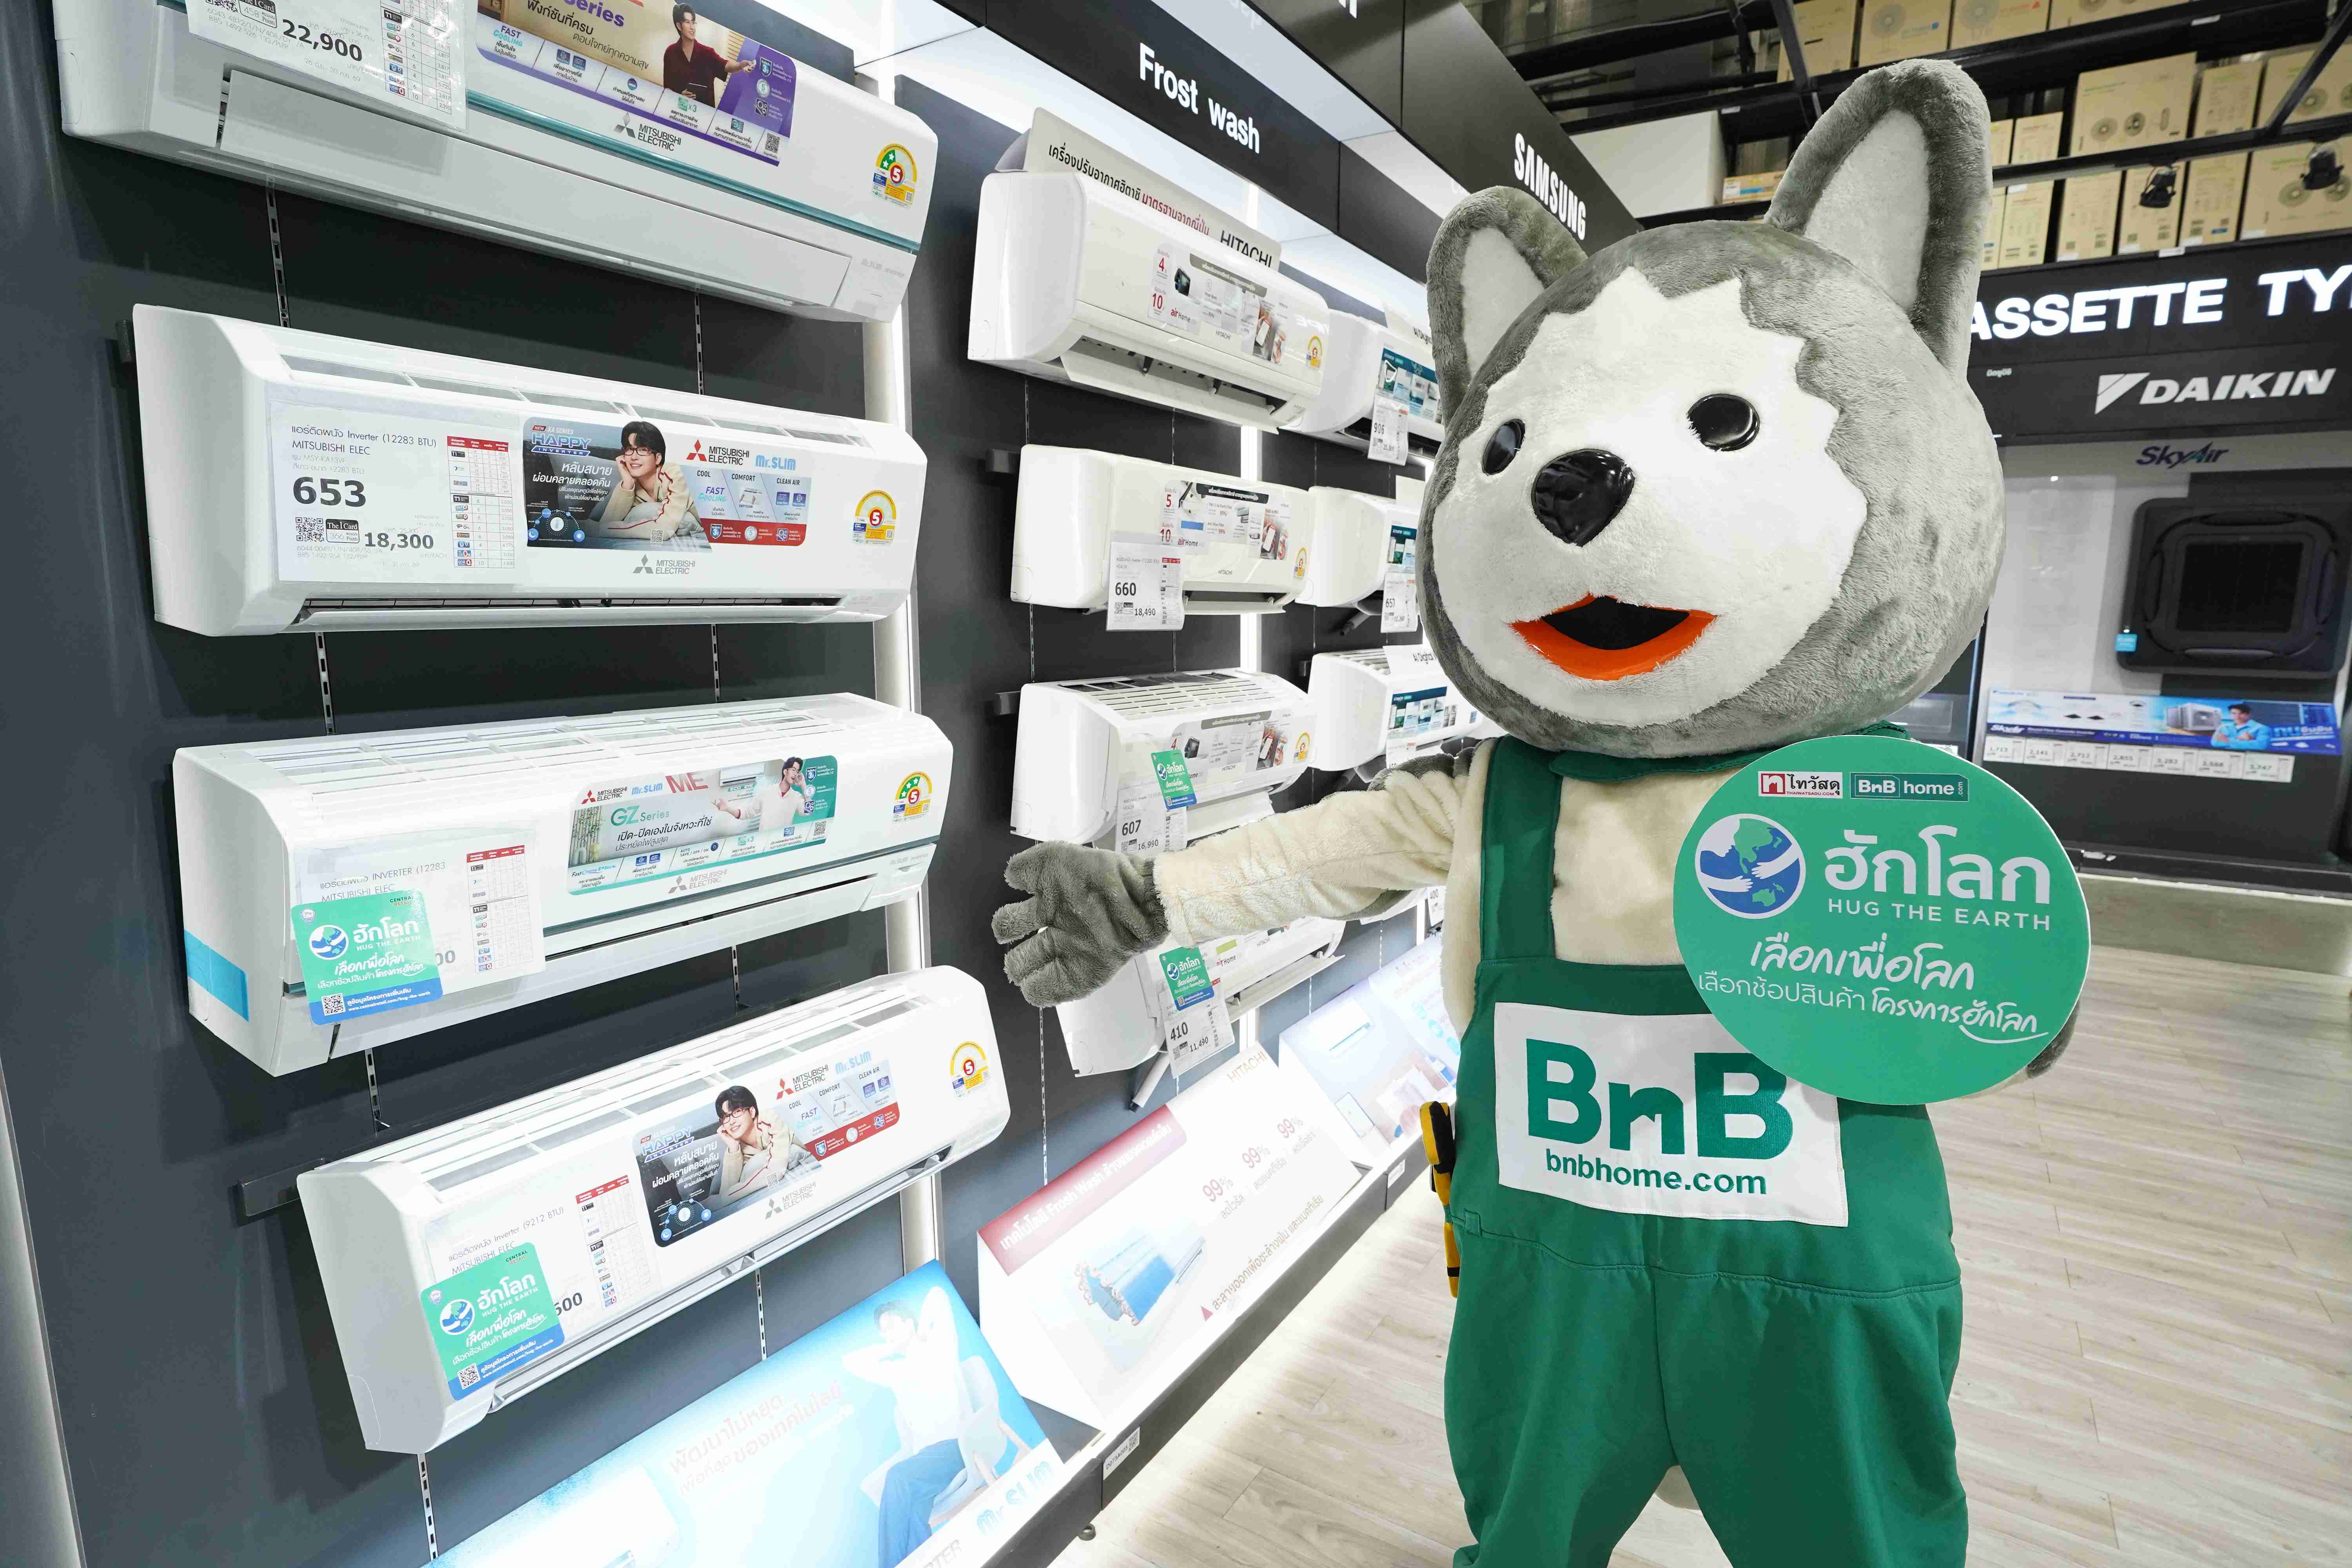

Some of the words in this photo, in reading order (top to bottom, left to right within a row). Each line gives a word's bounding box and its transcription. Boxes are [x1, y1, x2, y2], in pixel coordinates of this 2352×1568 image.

[207, 8, 225, 18] 6043
[209, 15, 223, 25] 885
[244, 6, 259, 18] 458
[262, 16, 276, 26] Points
[283, 19, 362, 61] 22,900
[493, 29, 523, 47] COOLING
[501, 26, 521, 38] FAST
[573, 33, 649, 69] ตอบโจทย์ทุกความสุข
[1140, 42, 1198, 114] Frost
[1208, 98, 1259, 154] wash
[637, 132, 675, 151] ELECTRIC
[639, 123, 682, 145] MITSUBISHI
[892, 167, 901, 182] 5
[1049, 143, 1141, 200] เครื่องปรับอากาศฮิตาชิ
[1142, 192, 1210, 236] มาตรฐานจากญี่ปุ่น
[1514, 132, 1586, 240] SAMSUNG
[1220, 230, 1272, 268] HITACHI
[1159, 258, 1164, 271] 4
[2258, 265, 2352, 316] TY
[1152, 293, 1163, 309] 10
[1216, 330, 1230, 339] HITACHI
[2139, 368, 2336, 405] DAIKIN
[292, 425, 343, 437] แอร์ติดผนัง
[348, 430, 378, 441] Inverter
[383, 434, 414, 445] (12283
[418, 437, 436, 448] BTU)
[1374, 423, 1384, 434] 906
[292, 440, 345, 452] MITSUBISHI
[350, 445, 370, 455] ELEC
[532, 433, 592, 449] HAPPY
[708, 454, 744, 465] ELECTRIC
[709, 446, 750, 458] MITSUBISHI
[2136, 441, 2230, 469] SkyAir
[561, 462, 612, 475] หลับสบาย
[731, 473, 756, 481] COMFORT
[533, 472, 611, 487] ผ่อนคลายตลอดคืน
[293, 477, 366, 508] 653
[698, 493, 726, 502] COOLING
[706, 486, 725, 495] FAST
[1166, 494, 1172, 508] 5
[872, 512, 880, 524] 5
[365, 532, 434, 551] 18,300
[1161, 529, 1171, 542] 10
[655, 566, 690, 575] ELECTRIC
[656, 559, 696, 569] MITSUBISHI
[1115, 582, 1136, 595] 660
[1386, 598, 1395, 608] 657
[1135, 608, 1156, 617] 18,490
[1167, 762, 1184, 773] ฮักโลก
[598, 786, 627, 796] MITSUBISHI
[1788, 774, 1840, 795] ไทวัสดุ
[1858, 779, 1896, 793] BnB
[1904, 781, 1954, 795] home
[597, 793, 623, 802] ELECTRIC
[911, 790, 917, 804] 5
[610, 805, 640, 826] GZ
[640, 810, 671, 822] Series
[617, 816, 713, 842] เปิด-ปิดเองในจังหวะที่ใช่
[1122, 820, 1141, 836] 607
[615, 836, 668, 852] ประหยัดไฟสูงสุด
[1138, 839, 1158, 850] 16,990
[373, 867, 412, 881] INVERTER
[416, 862, 445, 875] (12283
[1824, 824, 2050, 904] ฮักโลก
[689, 877, 721, 889] ELECTRIC
[690, 869, 727, 882] MITSUBISHI
[322, 887, 371, 902] MITSUBISHI
[375, 884, 395, 894] ELEC
[1829, 898, 1880, 916] HUG
[1891, 903, 1942, 922] THE
[1955, 907, 2051, 931] EARTH
[353, 916, 419, 943] ฮักโลก
[394, 935, 421, 944] EARTH
[335, 951, 405, 976] เลือกเพื่อโลก
[1179, 957, 1200, 971] ฮักโลก
[1750, 931, 1974, 991] เลือกเพื่อโลก
[318, 973, 374, 990] เลือกช้อปสินค้า
[376, 961, 426, 978] โครงการฮักโลก
[347, 988, 411, 1006] ดูข้อมูลโครงการเพิ่มเติม
[348, 991, 430, 1011] www.centralretail.com/hug-the-earth
[1699, 969, 1866, 1011] เลือกช้อปสินค้า
[1871, 987, 2038, 1035] โครงการฮักโลก
[1171, 1022, 1188, 1041] 410
[1190, 1036, 1208, 1052] 11,490
[793, 1065, 829, 1085] MITSUBISHI
[859, 1070, 872, 1080] CLEAN
[965, 1060, 974, 1074] 5
[1227, 1051, 1268, 1083] HITACHI
[795, 1074, 826, 1092] ELECTRIC
[819, 1083, 840, 1096] COMFORT
[789, 1101, 801, 1109] COOL
[1526, 1038, 1793, 1160] BnB
[801, 1108, 817, 1120] FAST
[641, 1126, 692, 1156] HAPPY
[650, 1141, 688, 1158] INVERTER
[674, 1141, 717, 1167] หลับสบาย
[653, 1153, 719, 1188] ผ่อนคลายตลอดคืน
[1546, 1148, 1766, 1195] bnbhome.com
[782, 1181, 817, 1202] MITSUBISHI
[1074, 1171, 1103, 1196] Wash
[783, 1191, 814, 1210] ELECTRIC
[494, 1227, 520, 1242] Inverter
[523, 1214, 545, 1229] (9212
[547, 1206, 564, 1219] BTU)
[452, 1250, 495, 1275] MITSUBISHI
[498, 1241, 515, 1254] ELEC
[505, 1250, 528, 1263] CENTRAL
[510, 1255, 528, 1265] RETAIL
[477, 1274, 536, 1310] ฮักโลก
[482, 1307, 497, 1317] HUG
[499, 1300, 513, 1310] THE
[515, 1287, 539, 1302] EARTH
[466, 1308, 527, 1347] เลือกเพื่อโลก
[452, 1334, 502, 1366] เลือกช้อปสินค้า
[501, 1313, 546, 1338] โครงการฮักโลก
[481, 1340, 537, 1373] ดูข้อมูลโครงการเพิ่มเติม
[483, 1339, 554, 1379] www.centralretail.com/hug-the-earth
